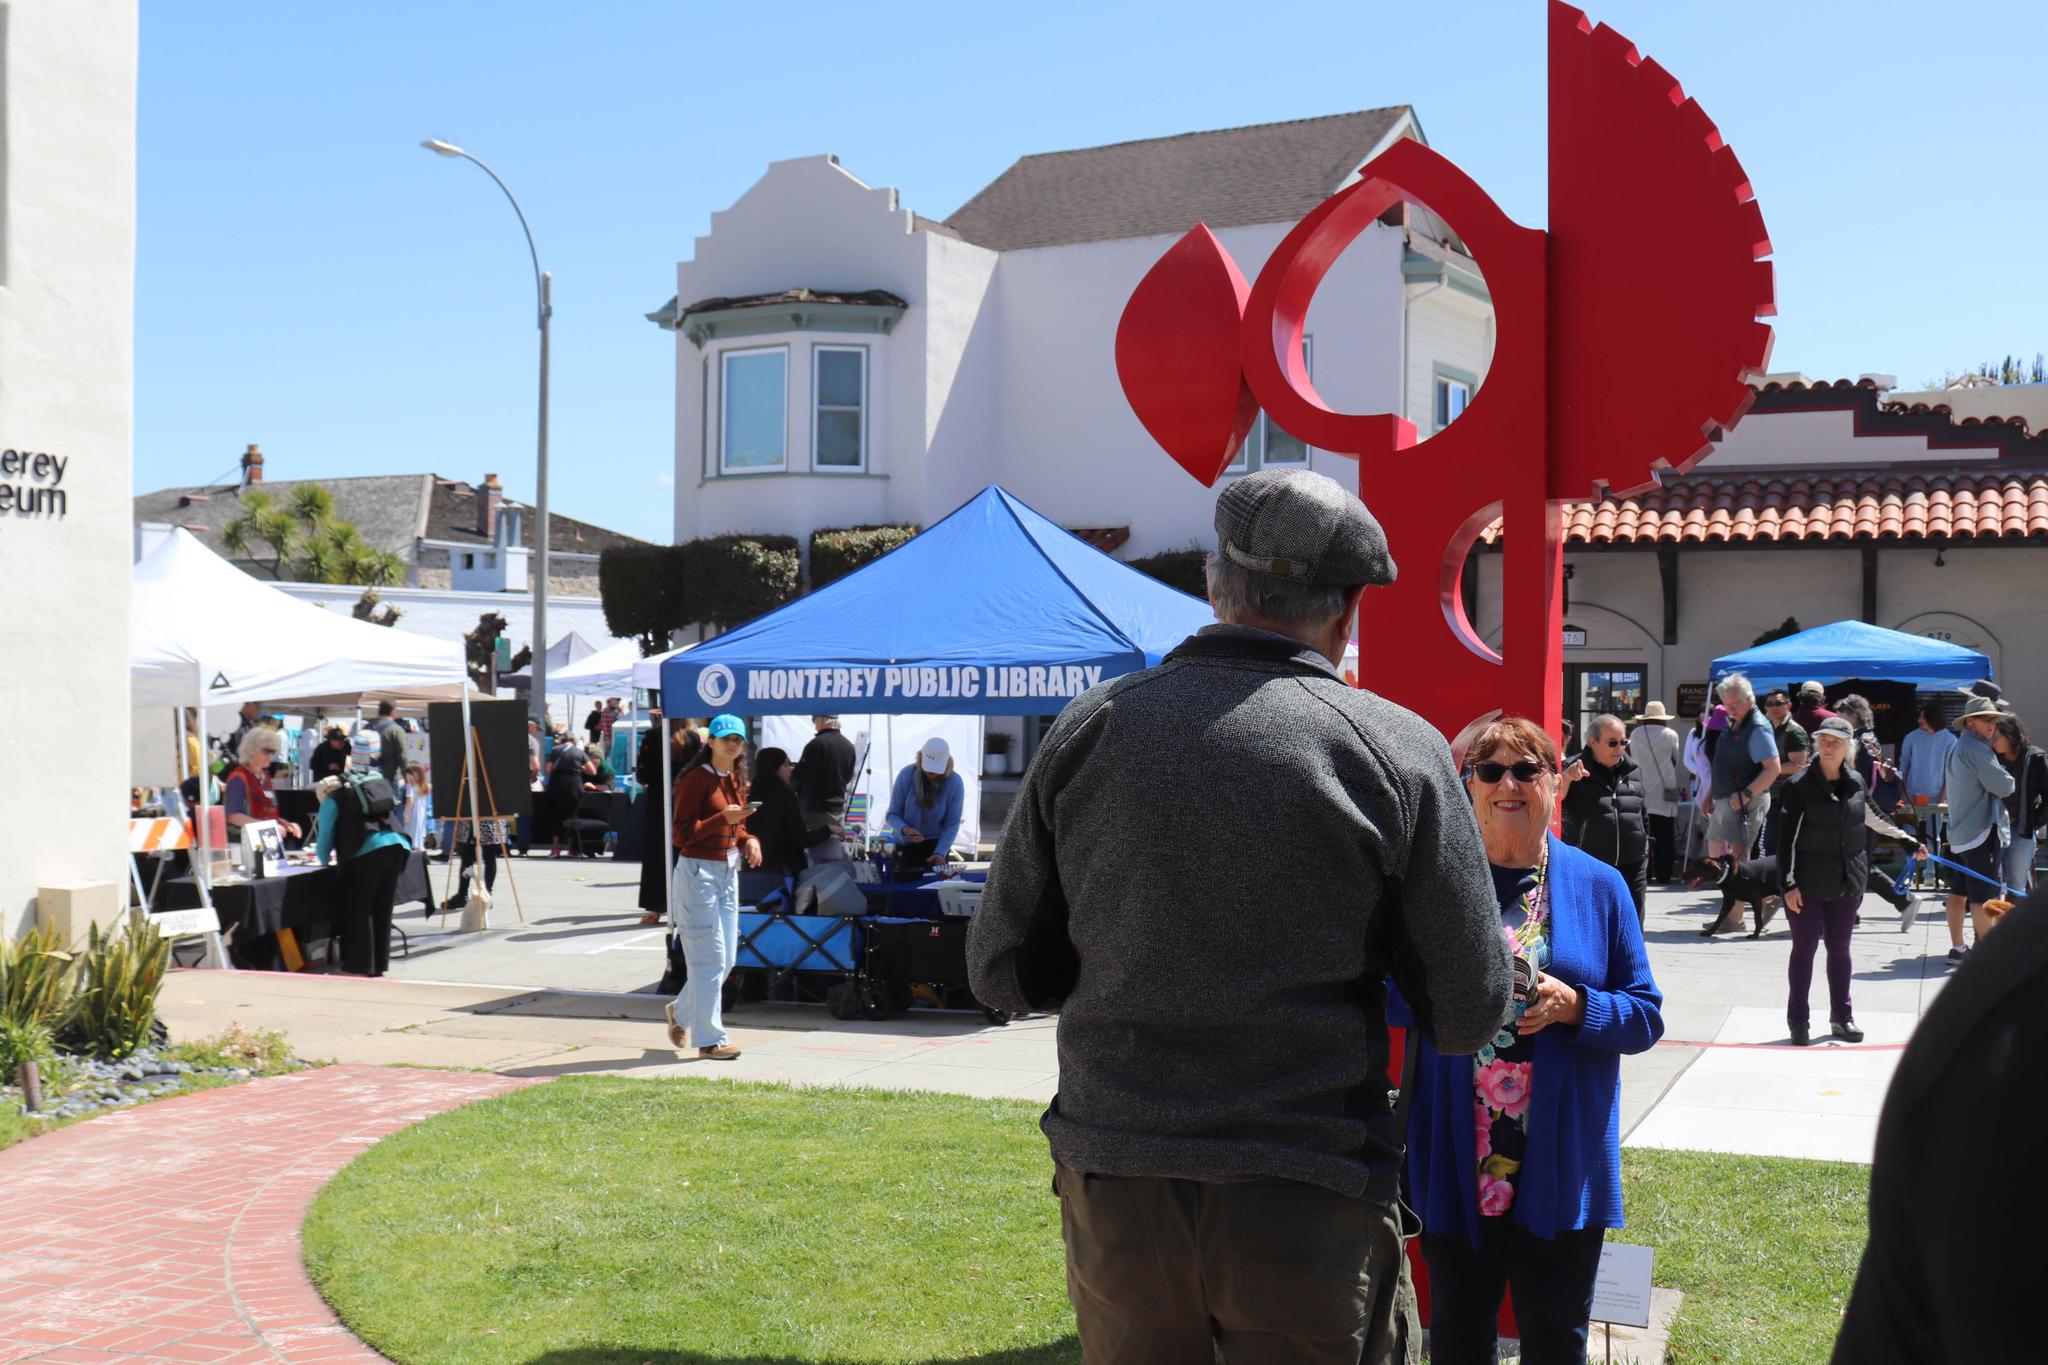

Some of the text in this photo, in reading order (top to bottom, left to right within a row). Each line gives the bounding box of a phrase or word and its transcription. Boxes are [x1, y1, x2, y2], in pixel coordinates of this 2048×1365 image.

[748, 668, 880, 700] MONTEREY
[884, 667, 980, 699] PUBLIC
[985, 665, 1102, 698] LIBRARY
